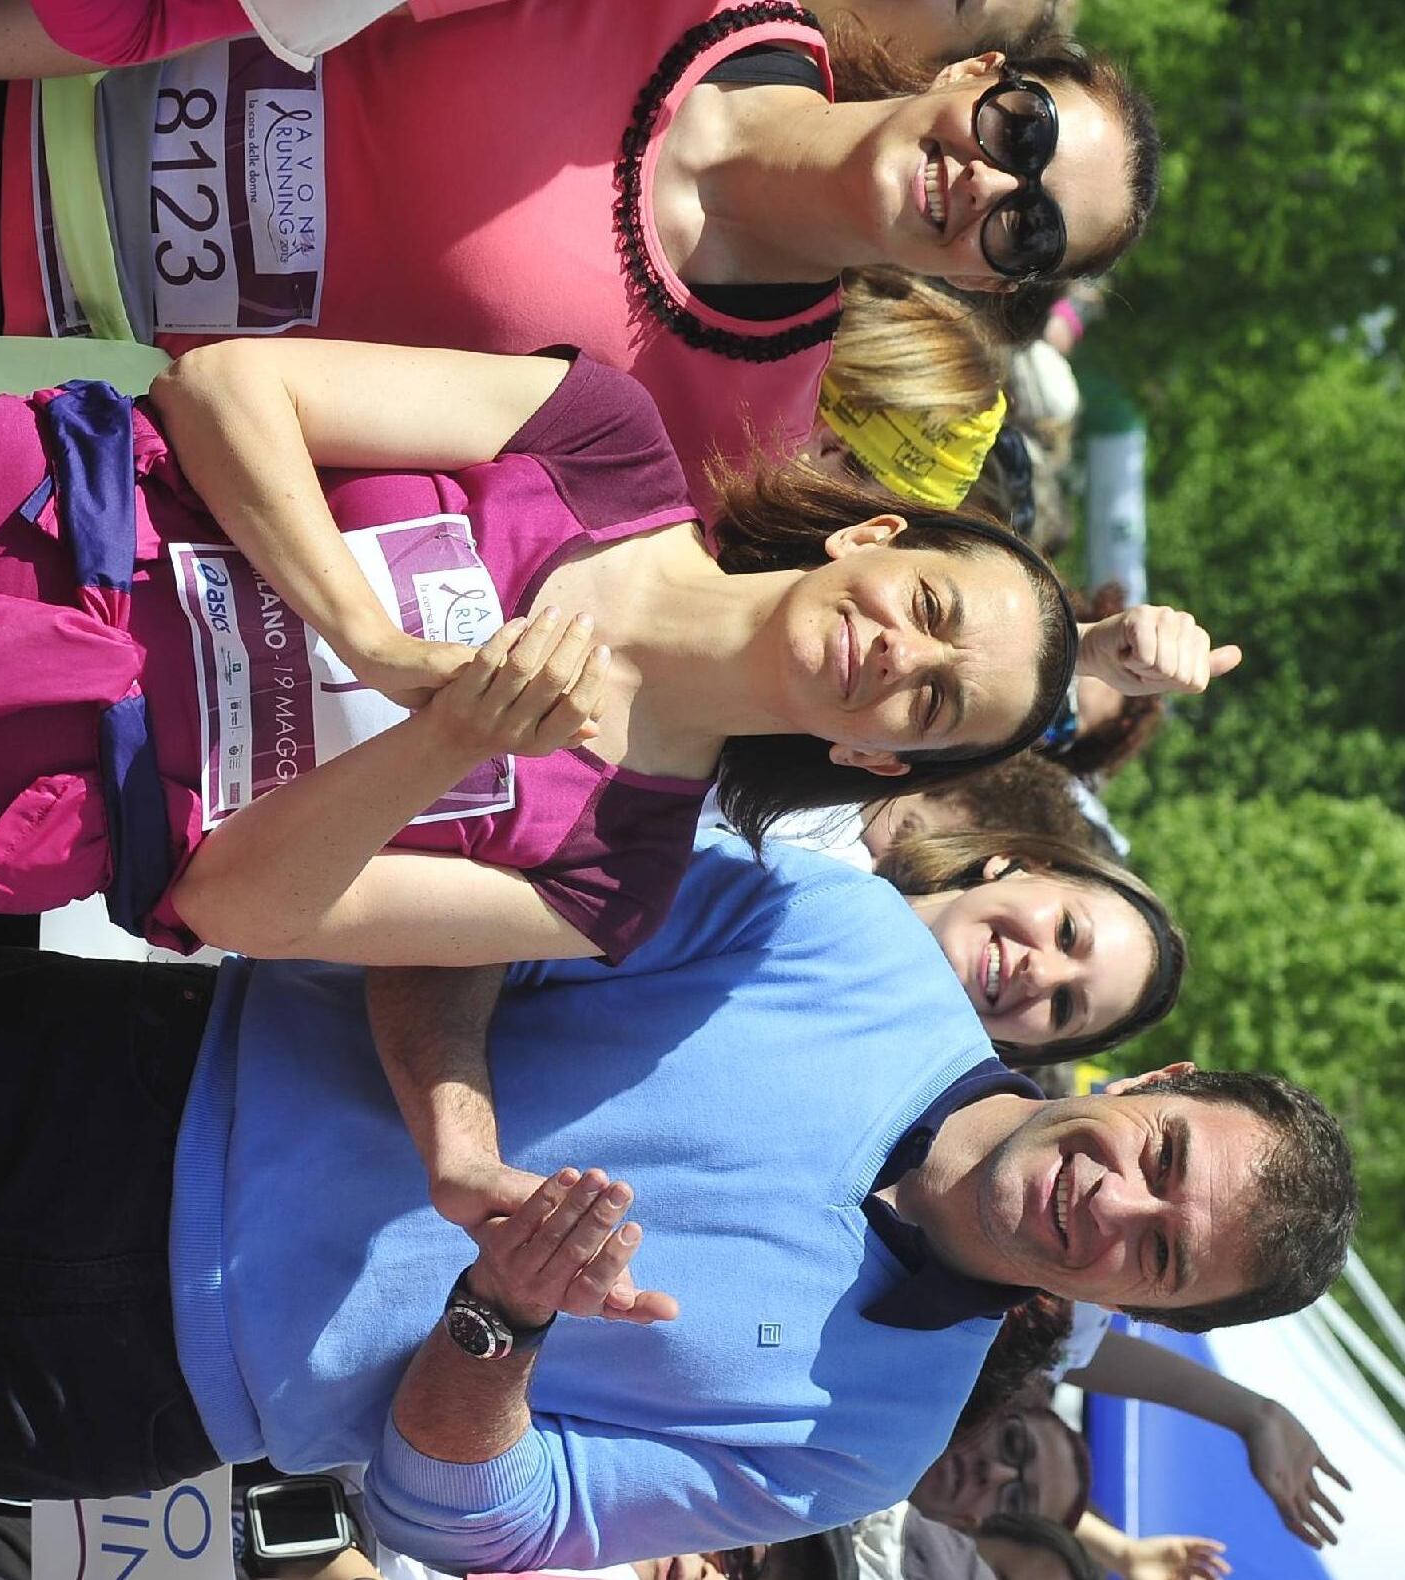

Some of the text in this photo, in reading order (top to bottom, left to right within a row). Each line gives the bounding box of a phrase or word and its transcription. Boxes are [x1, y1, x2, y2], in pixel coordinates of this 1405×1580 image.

[151, 88, 226, 286] 8123
[247, 99, 260, 203] la corsa delle donne
[275, 127, 294, 264] RUNNING 2013
[296, 127, 314, 233] AVON
[273, 667, 295, 689] 19
